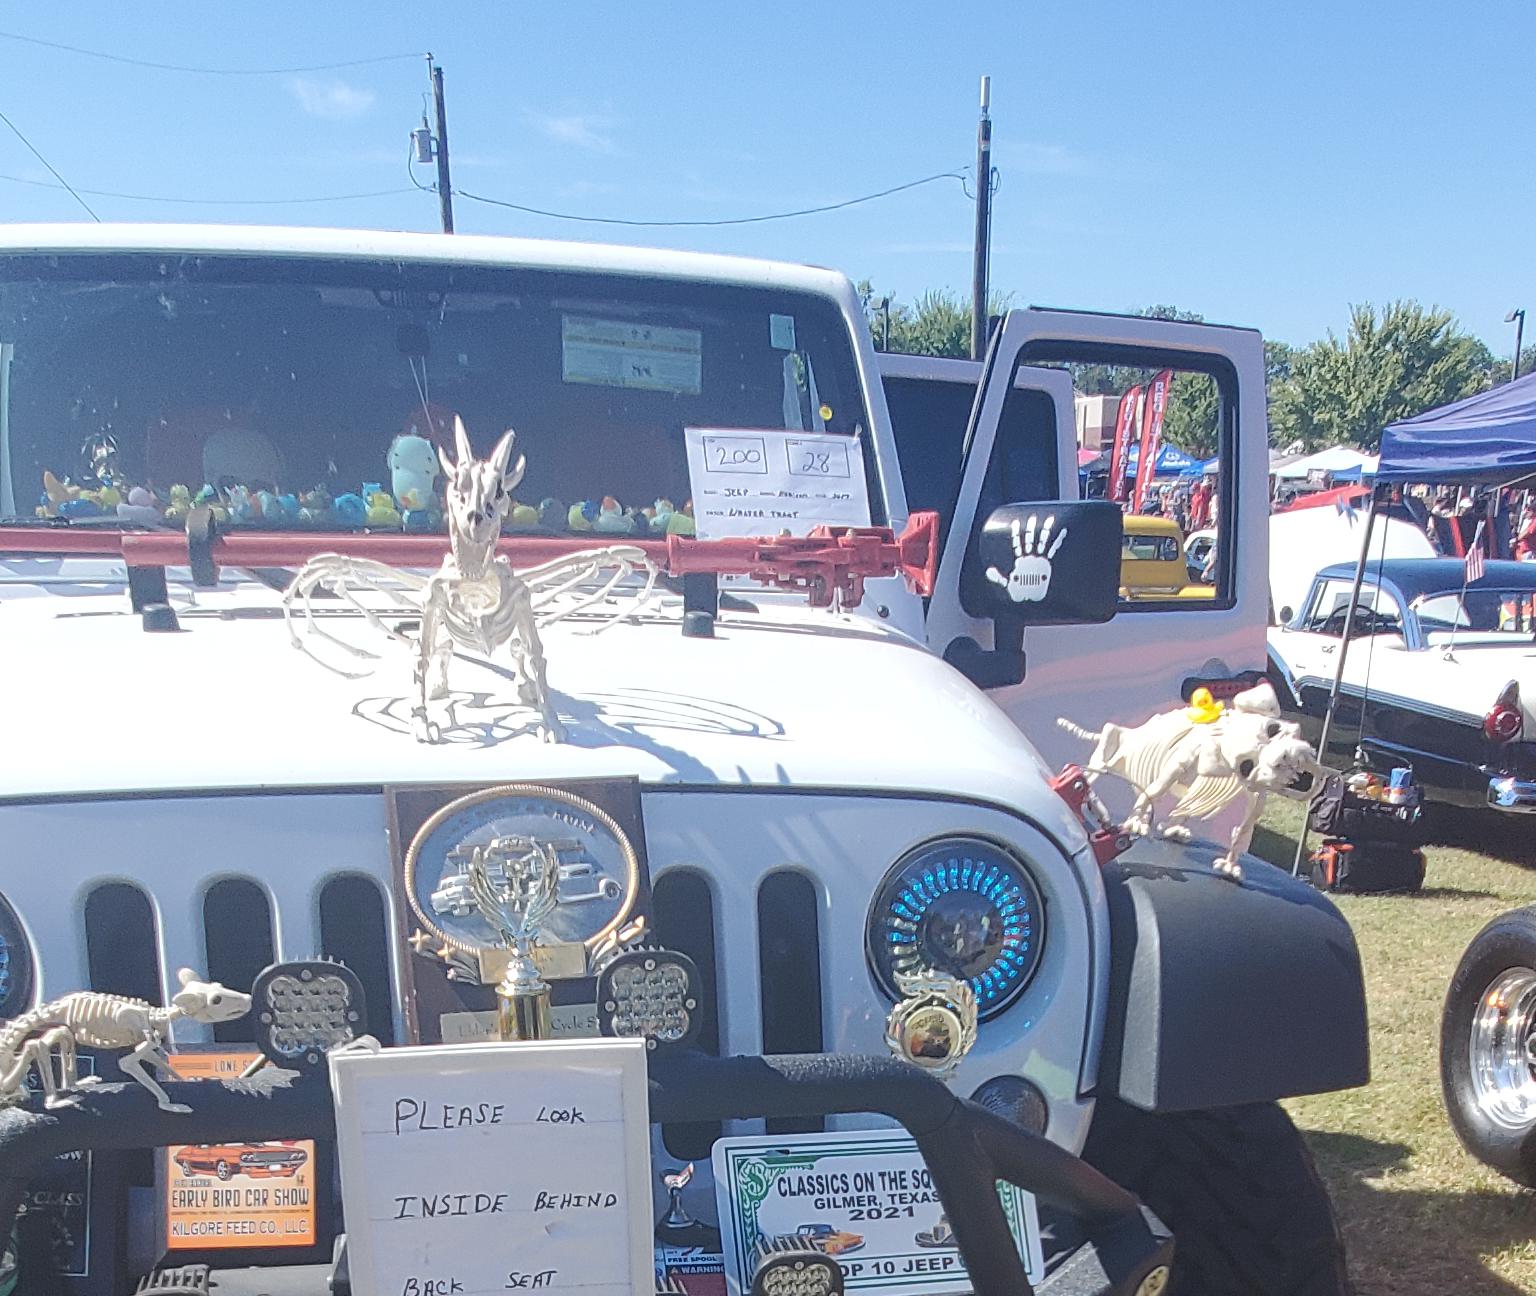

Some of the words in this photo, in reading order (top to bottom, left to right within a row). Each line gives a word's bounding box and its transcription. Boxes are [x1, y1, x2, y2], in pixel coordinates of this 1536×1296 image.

[716, 447, 760, 465] 200
[802, 451, 831, 473] 28
[395, 1098, 504, 1135] PLEASE
[777, 1173, 848, 1198] CLASSICS
[854, 1173, 875, 1193] ON
[878, 1171, 908, 1192] THE
[172, 1190, 208, 1208] EARLY
[213, 1189, 240, 1207] BIRD
[246, 1189, 268, 1207] CAR
[274, 1188, 309, 1206] SHOW
[394, 1194, 508, 1219] INSIDE
[534, 1192, 617, 1212] BEHIND
[814, 1195, 883, 1210] GILMER,
[887, 1191, 941, 1206] TEXAS
[848, 1206, 916, 1221] 2021
[172, 1222, 222, 1236] KILGORE
[226, 1220, 256, 1235] FEED
[840, 1261, 861, 1277] OP
[871, 1260, 895, 1275] 10
[902, 1257, 954, 1273] JEEP
[505, 1271, 557, 1288] SEAT
